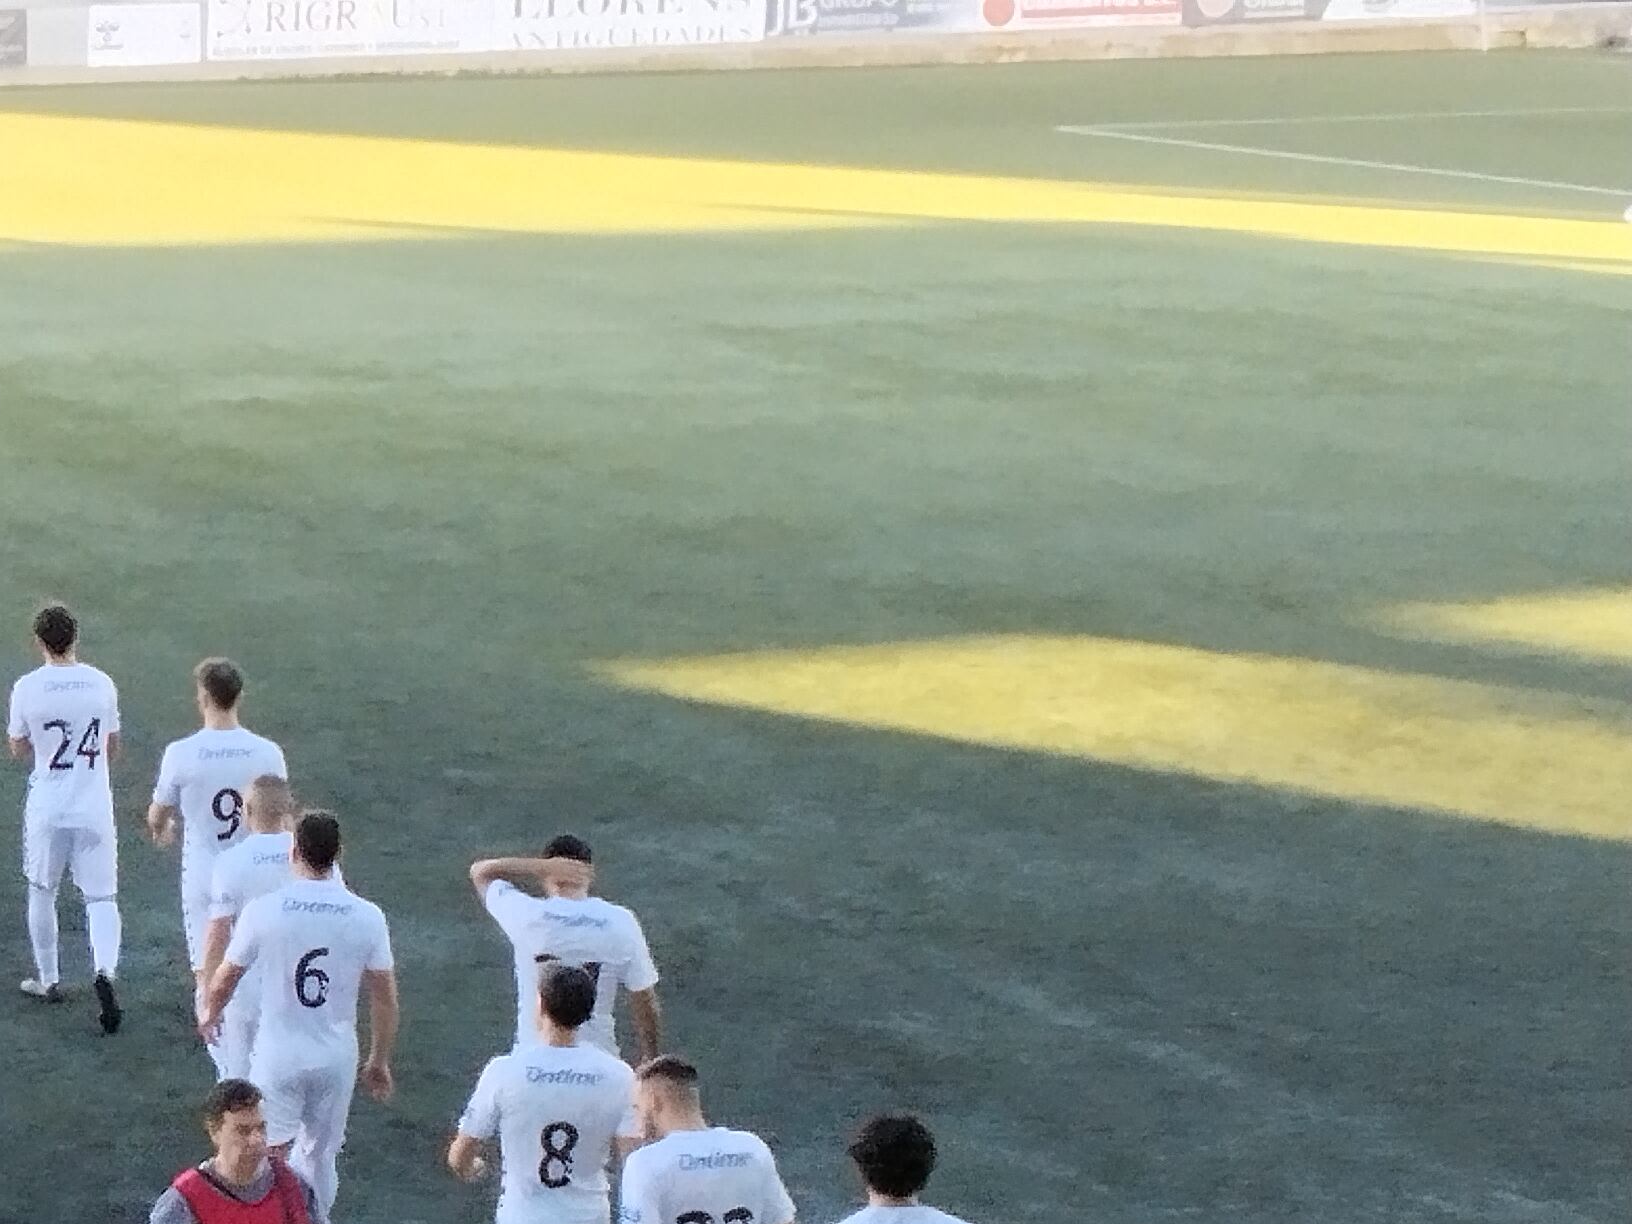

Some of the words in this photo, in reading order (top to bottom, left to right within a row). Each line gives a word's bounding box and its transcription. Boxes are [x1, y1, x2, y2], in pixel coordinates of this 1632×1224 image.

[43, 716, 102, 771] 24
[211, 787, 244, 840] 9
[295, 946, 330, 1009] 6
[538, 1120, 580, 1190] 8
